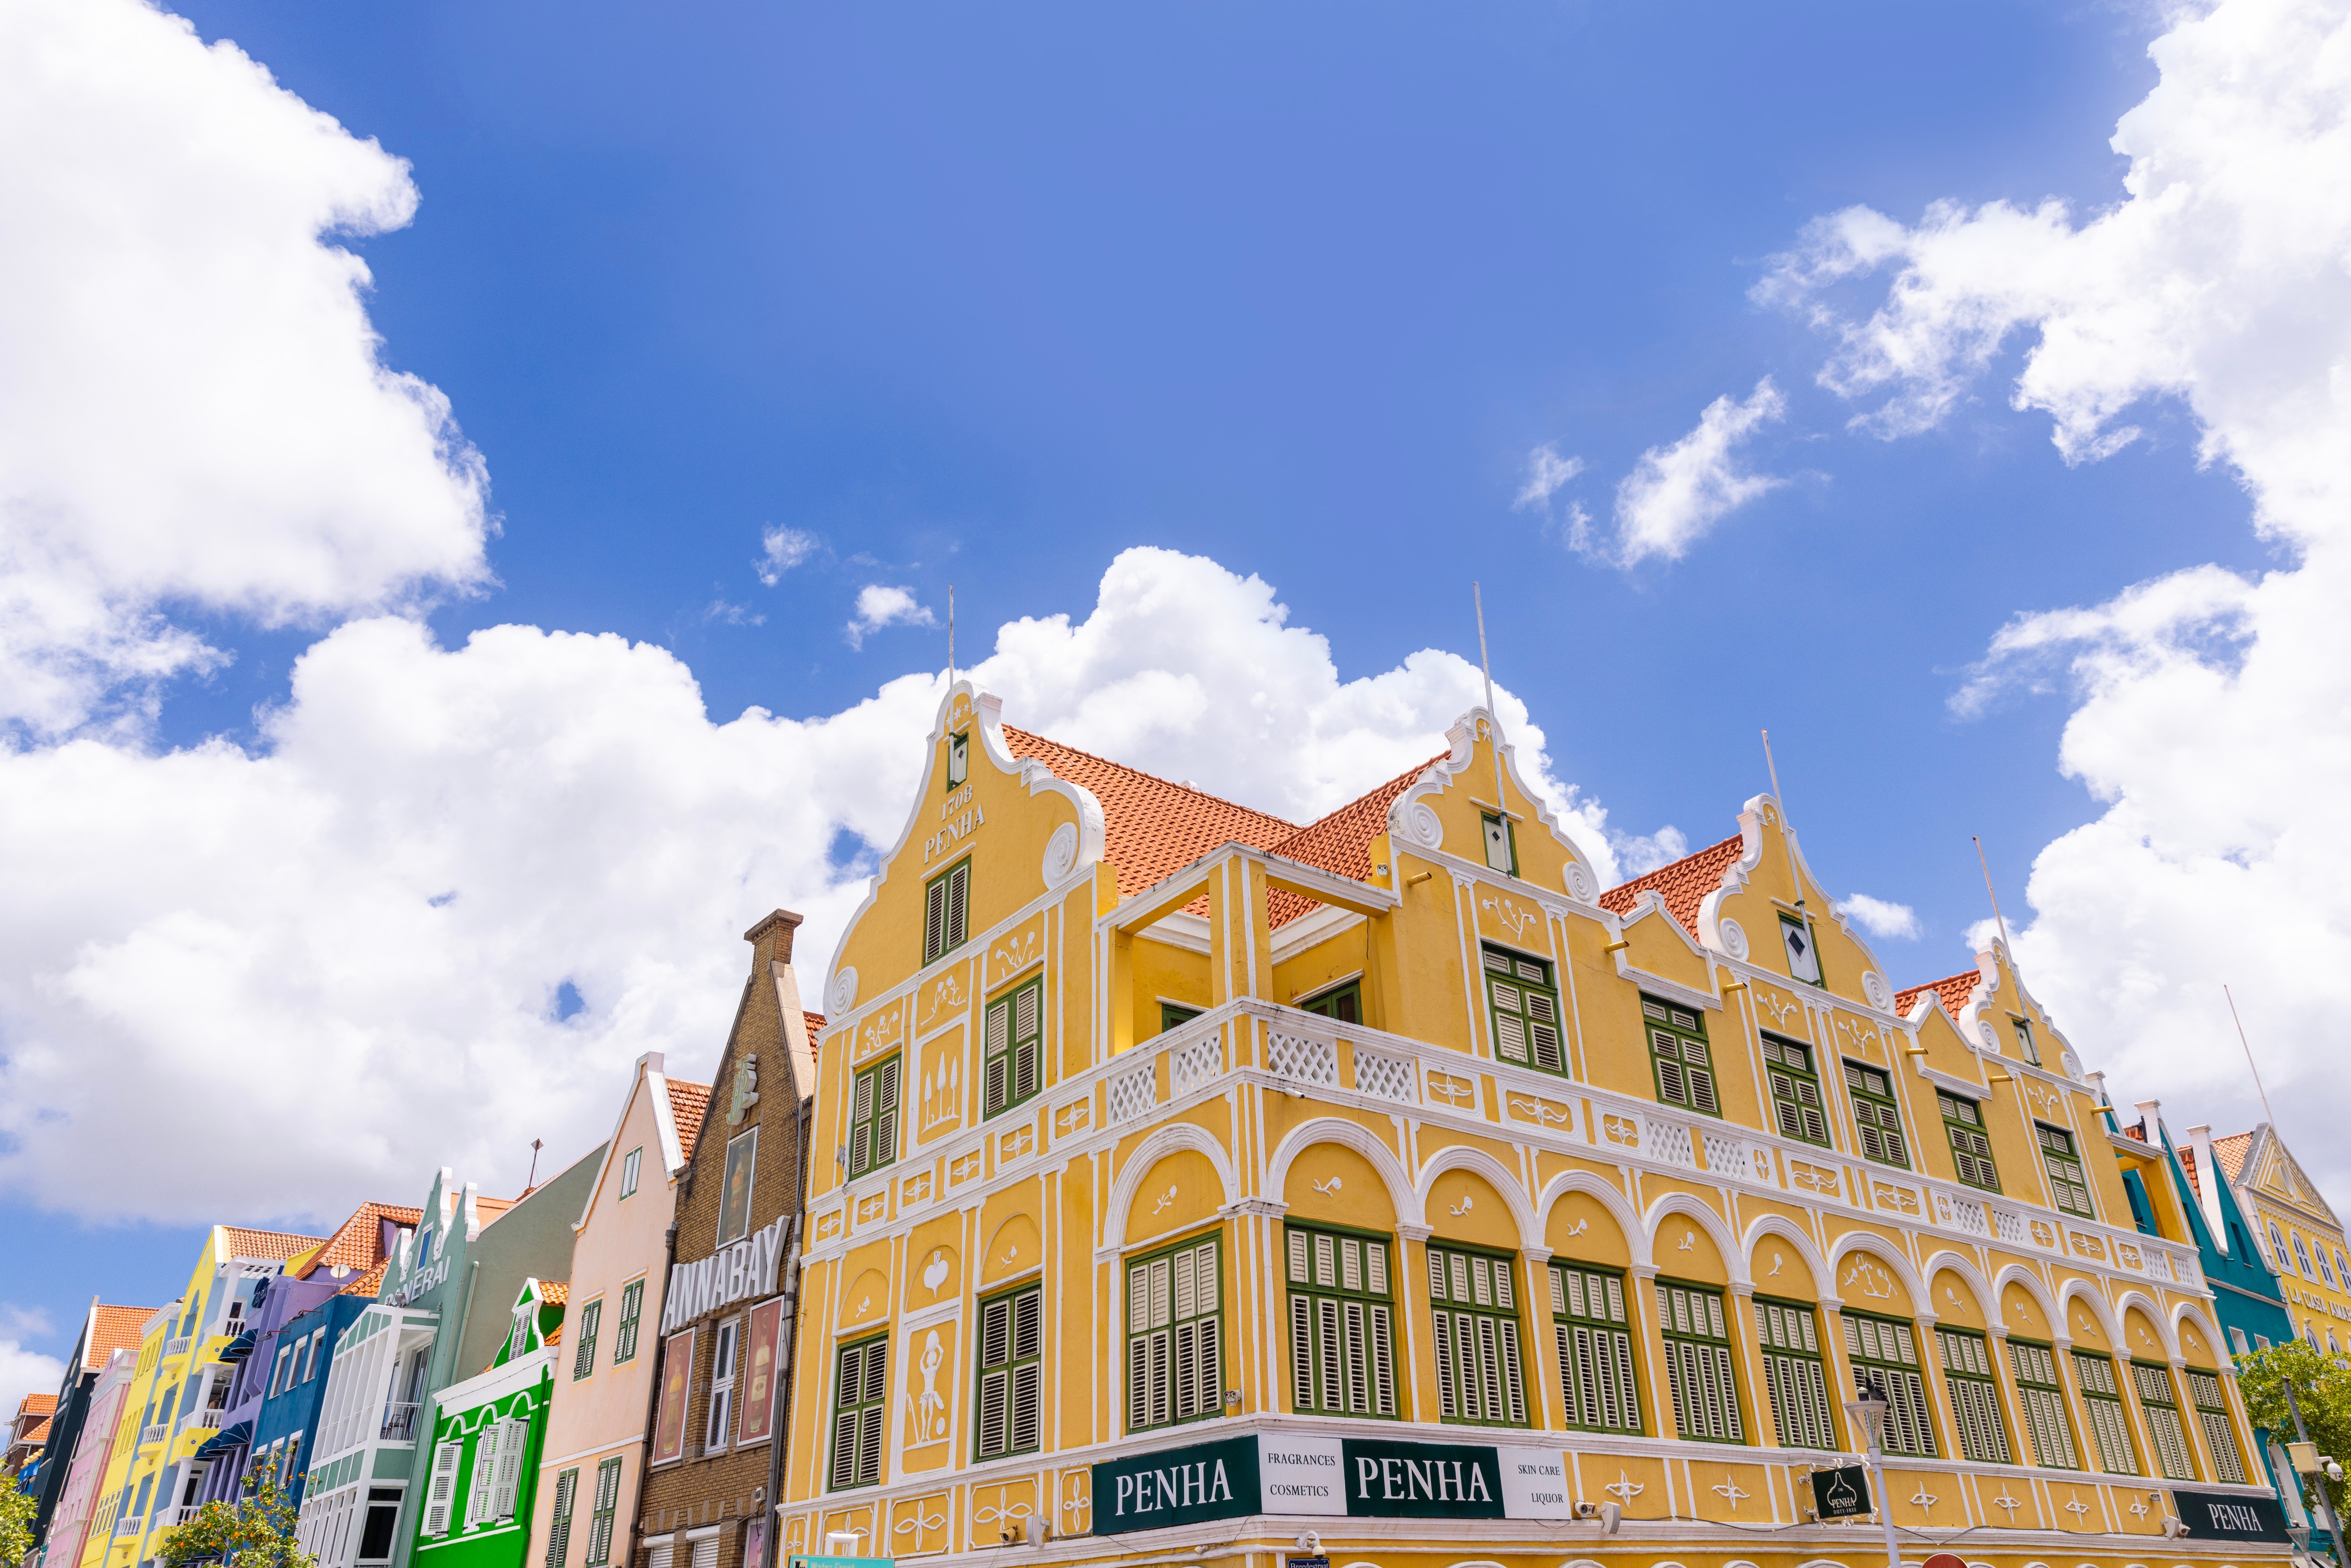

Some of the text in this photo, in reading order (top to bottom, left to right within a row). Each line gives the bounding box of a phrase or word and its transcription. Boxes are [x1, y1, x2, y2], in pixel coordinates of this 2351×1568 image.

[942, 784, 973, 821] 1708
[924, 804, 986, 864] PENHA
[660, 1215, 791, 1337] ANNABAY
[2287, 1285, 2304, 1305] LA
[2302, 1290, 2329, 1314] CASA
[1268, 1453, 1336, 1466] FRAGRANCES
[1518, 1464, 1560, 1475] SKIN CARE
[1115, 1459, 1234, 1516] PENHA
[1270, 1484, 1329, 1497] COSMETICS
[1355, 1457, 1493, 1502] PENHA
[1531, 1493, 1564, 1505] LIQUOR
[1831, 1497, 1856, 1509] PENHA
[2207, 1504, 2264, 1532] PENHA
